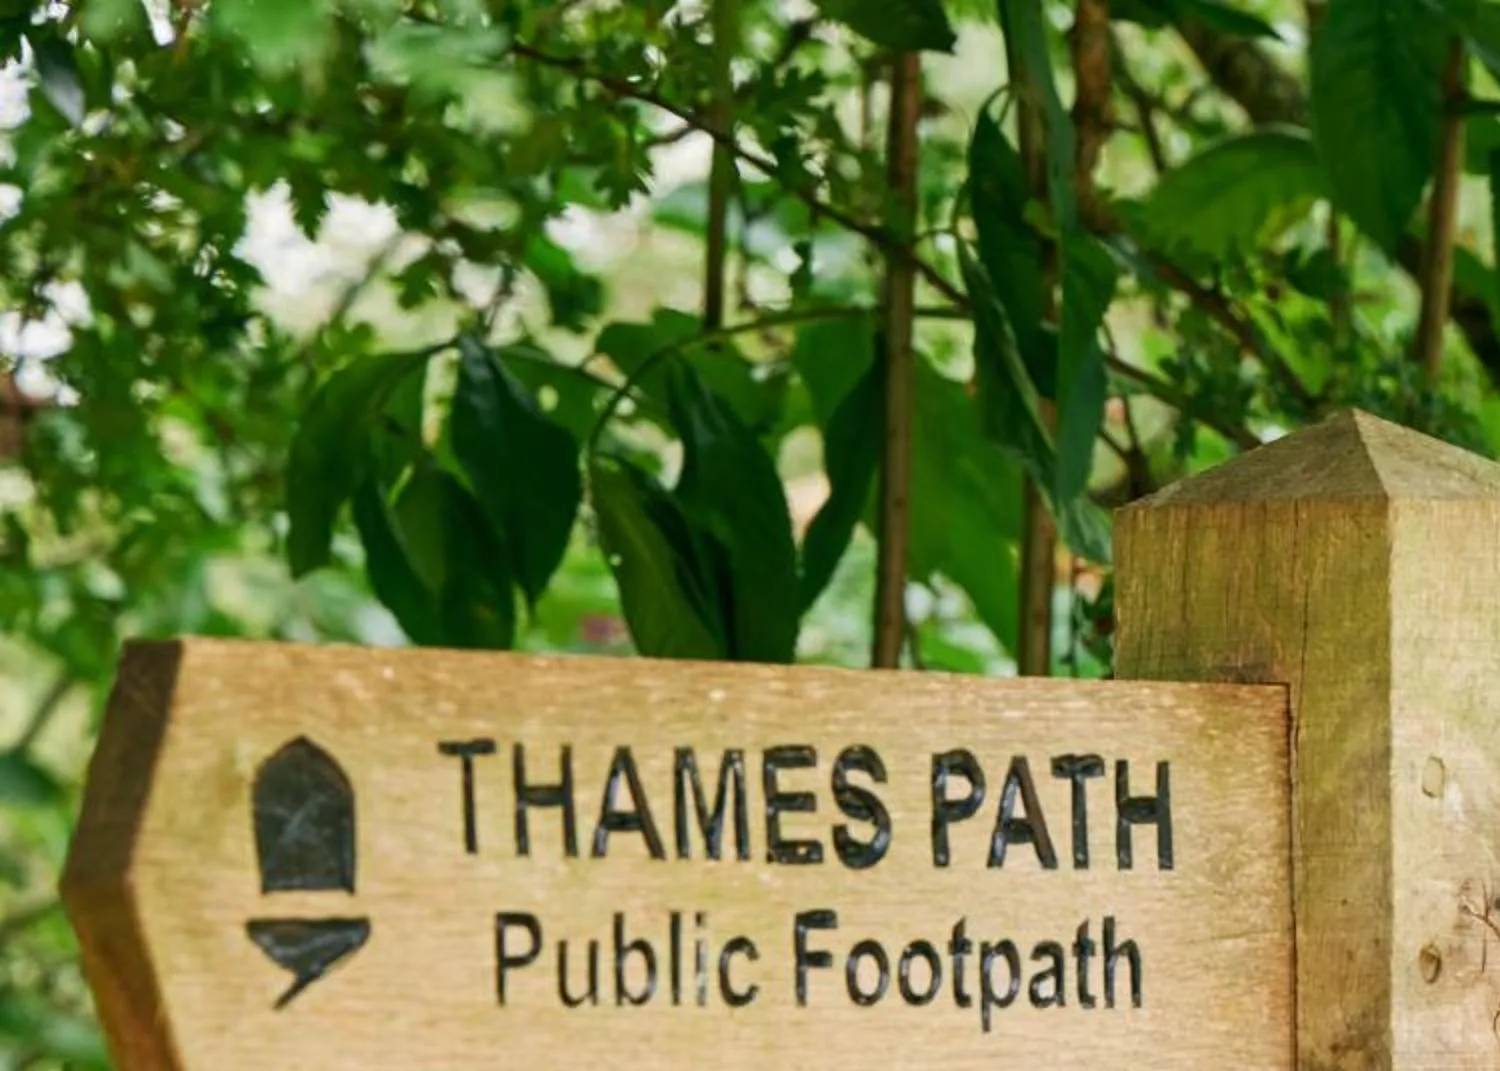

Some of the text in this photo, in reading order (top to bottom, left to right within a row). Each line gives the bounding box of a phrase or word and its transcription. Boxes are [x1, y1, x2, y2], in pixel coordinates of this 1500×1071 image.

[438, 738, 1176, 871] THAMES PATH
[494, 908, 1144, 1033] Public Footpath
